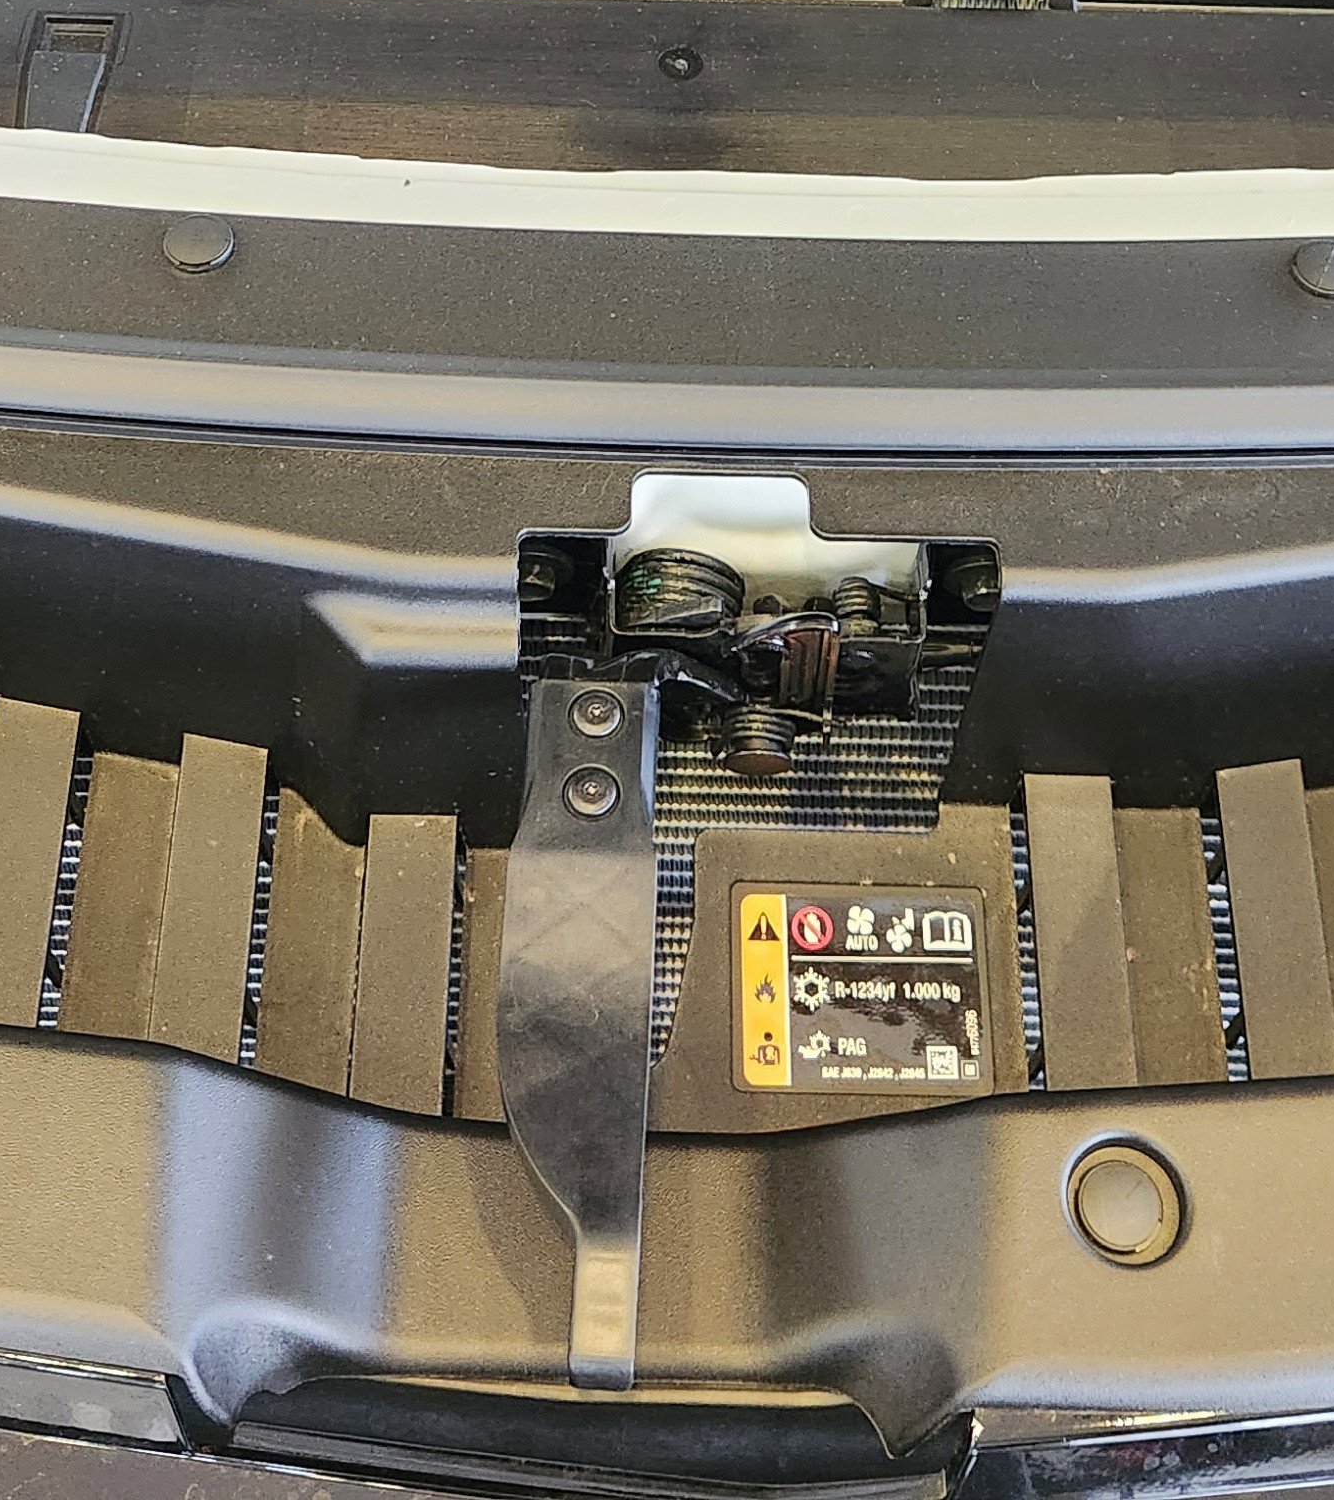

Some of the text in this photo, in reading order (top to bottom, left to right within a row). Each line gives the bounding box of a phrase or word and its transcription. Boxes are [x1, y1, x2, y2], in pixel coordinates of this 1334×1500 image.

[845, 934, 879, 951] AUTO
[834, 981, 961, 1003] R-1234yf 1.000 kg
[837, 1037, 867, 1056] PAG
